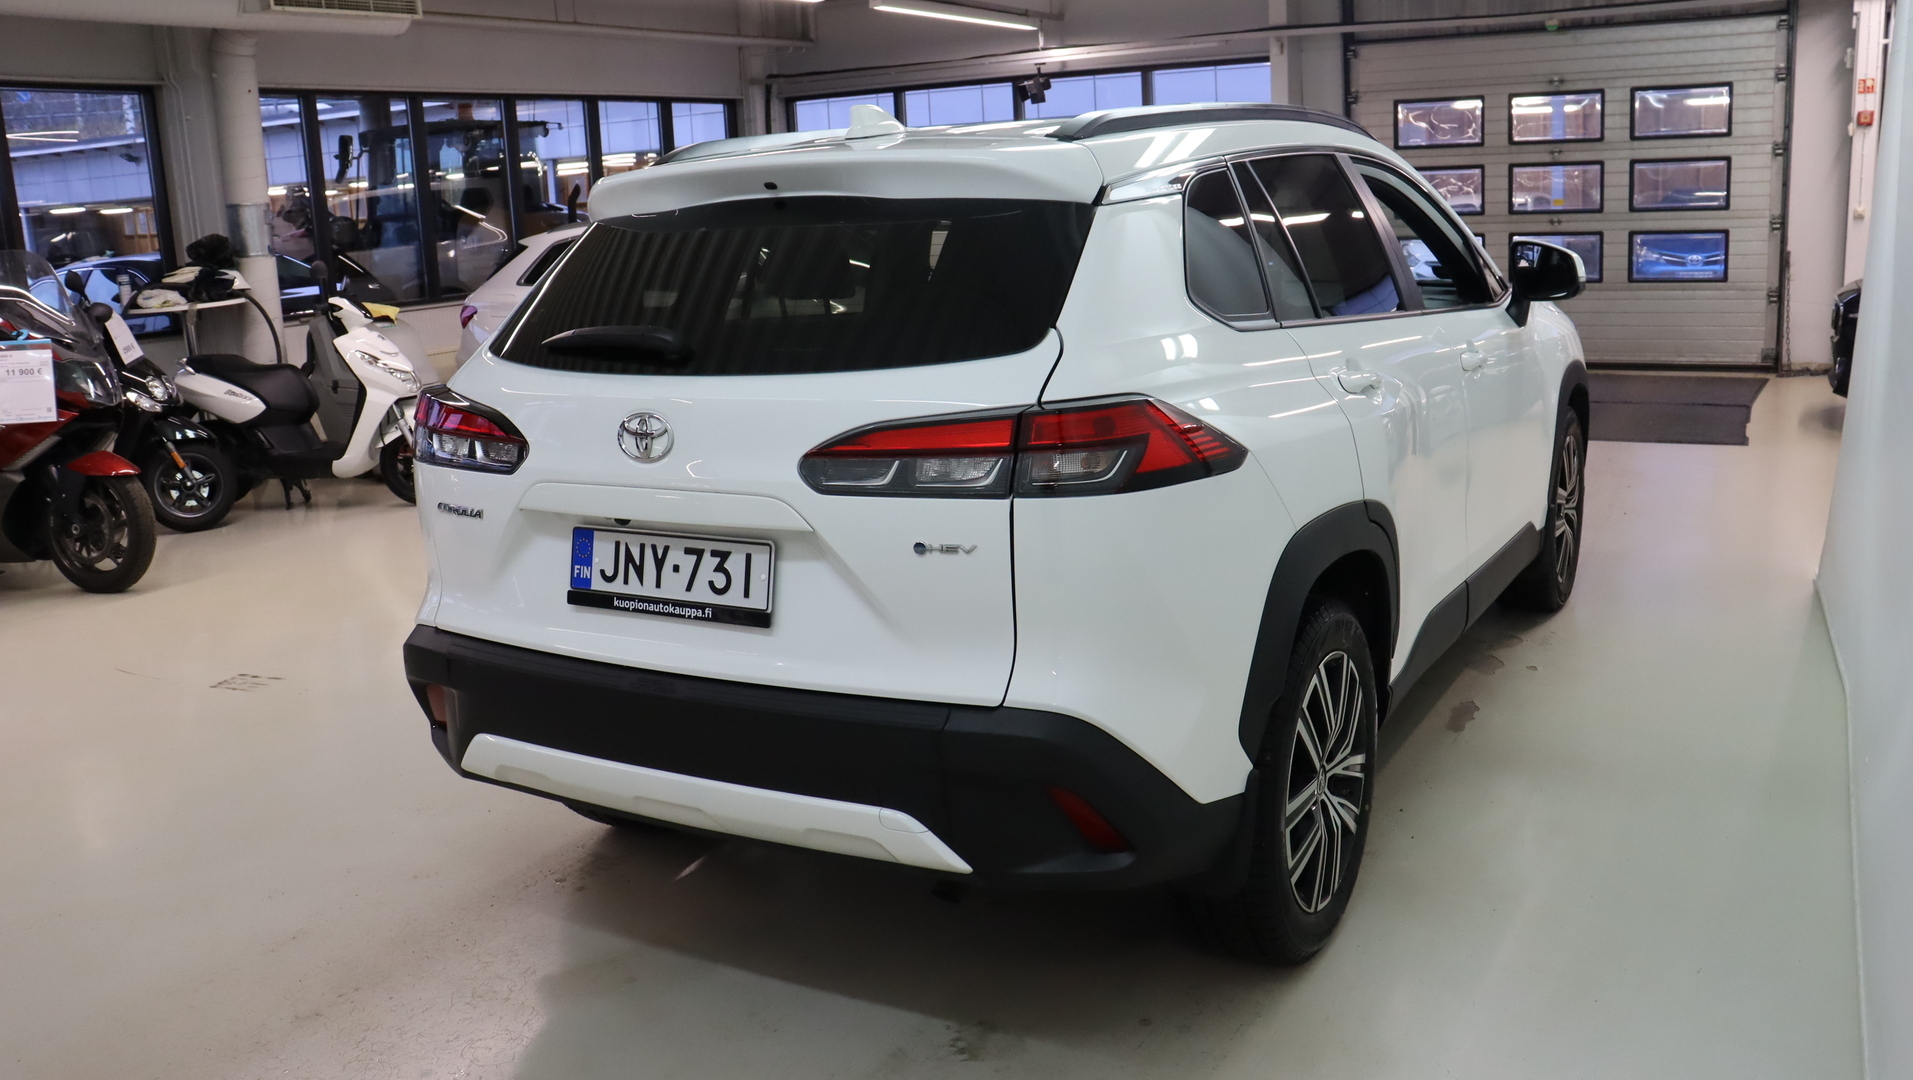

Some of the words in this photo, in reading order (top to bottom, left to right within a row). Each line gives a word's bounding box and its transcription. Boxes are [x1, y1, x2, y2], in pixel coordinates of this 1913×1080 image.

[18, 368, 35, 376] 900
[37, 367, 43, 375] €
[574, 565, 591, 579] FIN
[613, 597, 713, 619] kuopionautokauppa.fi
